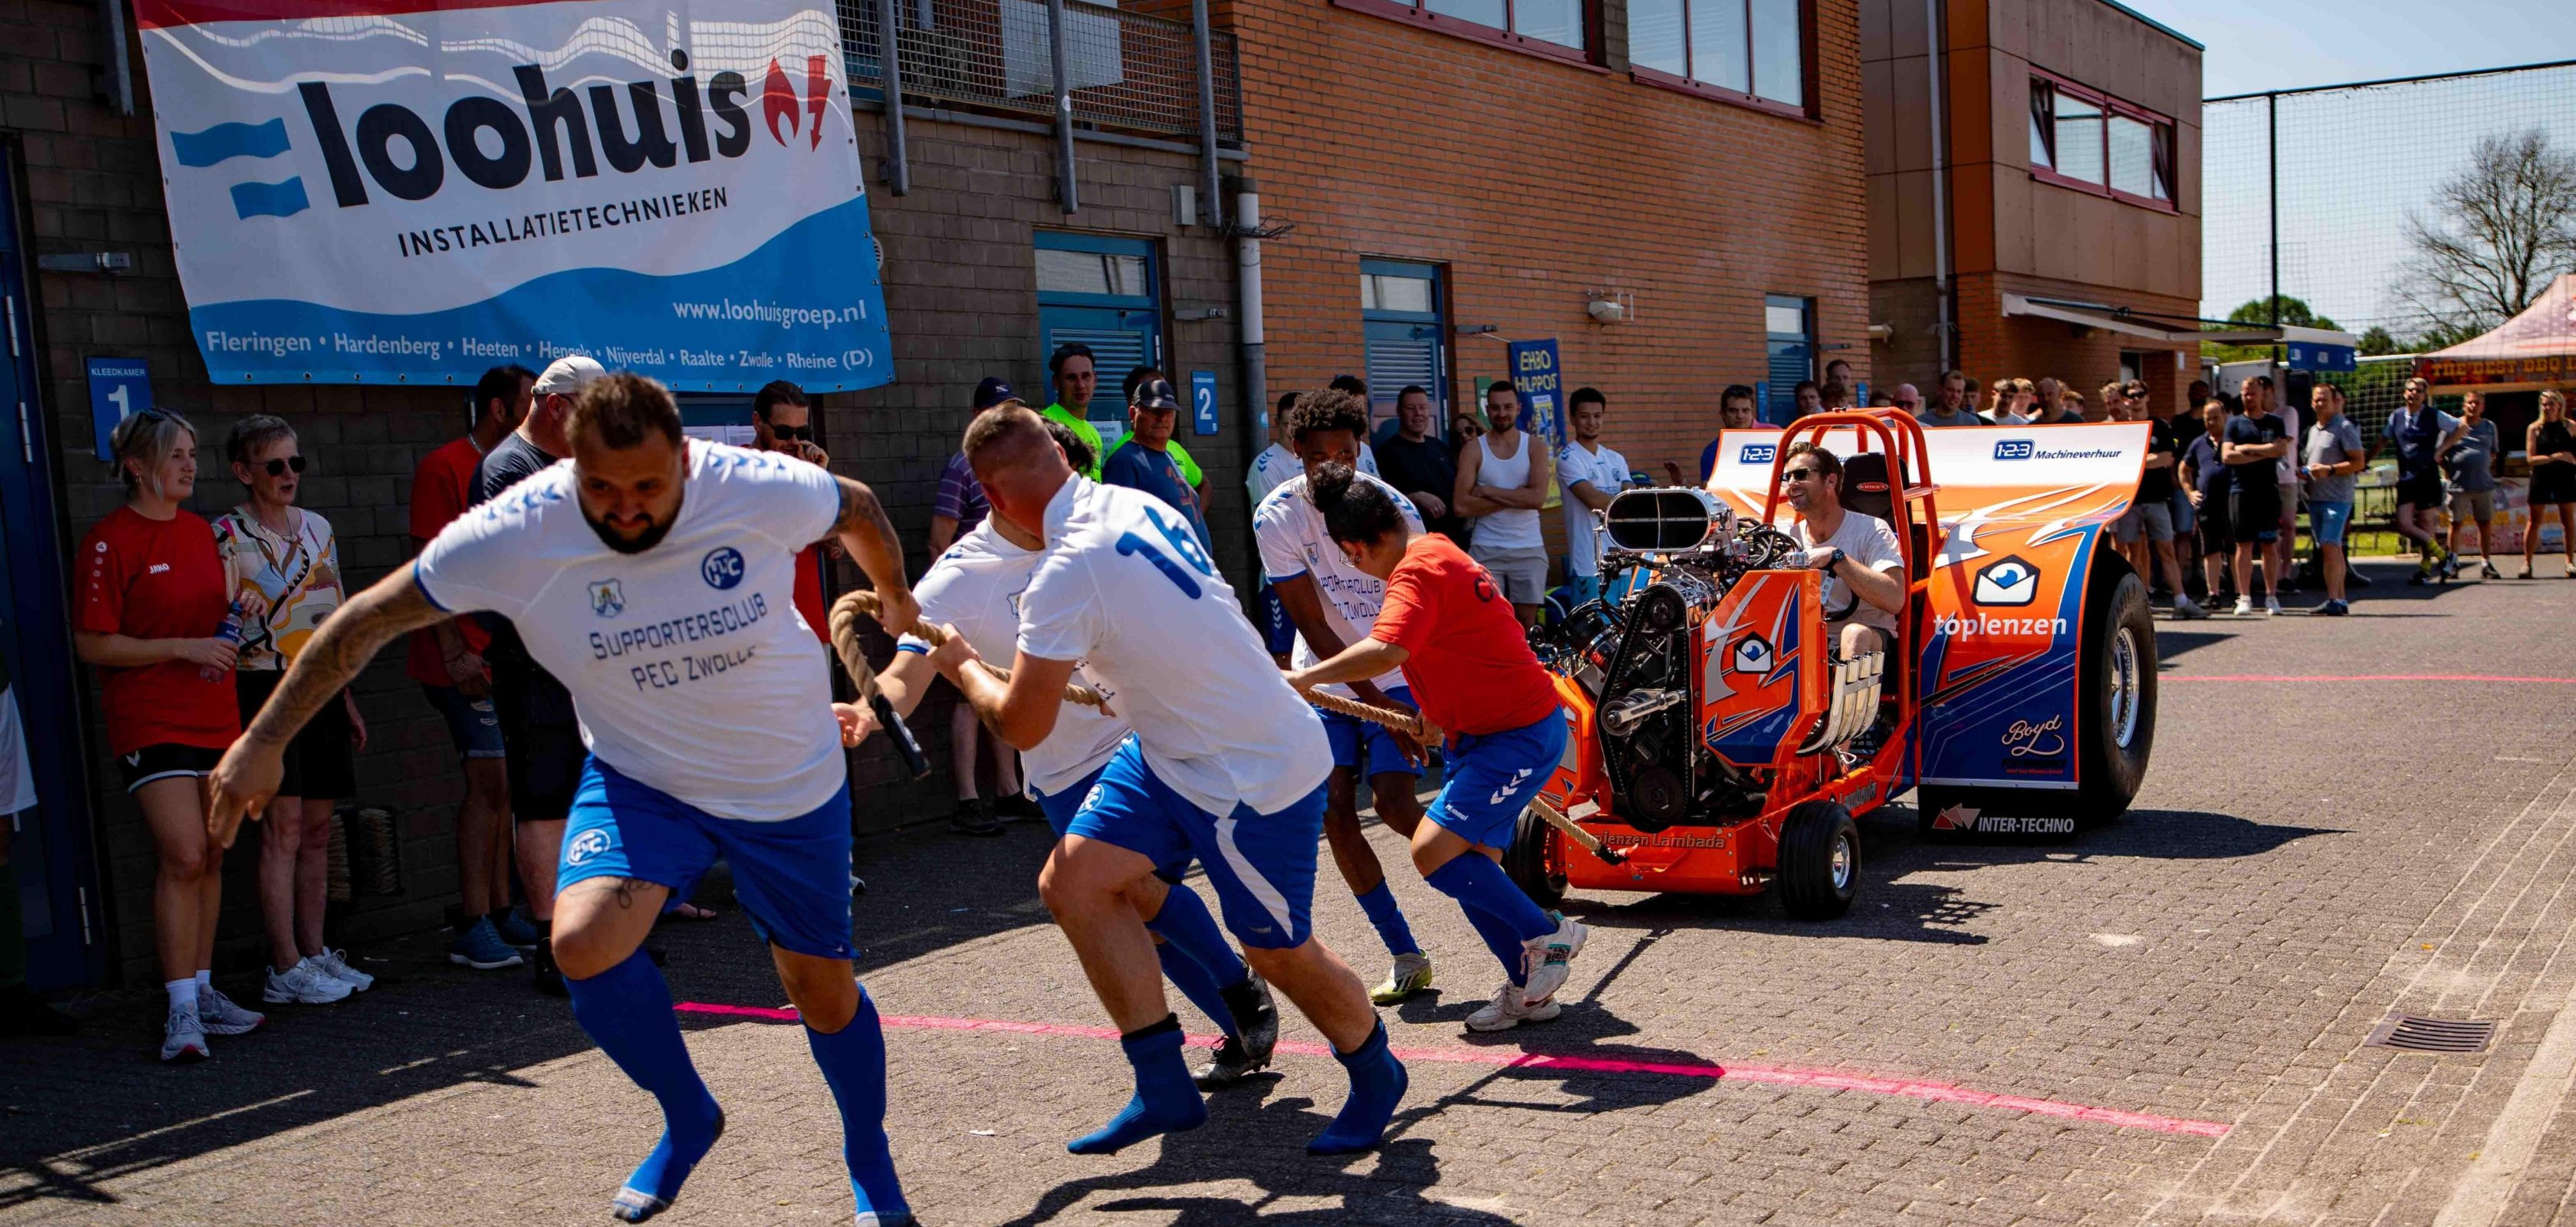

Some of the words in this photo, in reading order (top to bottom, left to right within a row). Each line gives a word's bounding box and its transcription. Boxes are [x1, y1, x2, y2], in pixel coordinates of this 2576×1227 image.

[297, 49, 751, 208] loohuis
[398, 186, 728, 258] INSTALLATIETECHNIEKEN
[673, 298, 866, 331] www.loohuisgroep.nl
[205, 331, 311, 357] Fleringen
[334, 332, 441, 360] Hardenberg
[462, 337, 519, 357] Heeten
[606, 346, 664, 368] Nijverdal
[680, 349, 725, 366] Raalte
[739, 350, 774, 367] Zwolle
[787, 352, 837, 369] Rheine
[843, 348, 873, 370] (D)
[1520, 350, 1552, 370] EHBO
[91, 368, 146, 377] KLEEDKAMER
[107, 385, 130, 423] 1
[1198, 387, 1213, 420] 2
[2034, 448, 2122, 459] Machineverhuur
[149, 563, 170, 574] JAKO
[1115, 505, 1213, 600] 16
[589, 592, 768, 660] SUPPORTERSCLUB
[1933, 613, 2068, 642] toplenzen
[630, 660, 679, 692] PEC
[2001, 714, 2065, 757] Boyd
[1593, 831, 1649, 846] plenzen
[1651, 834, 1727, 848] Lambada
[1978, 817, 2075, 833] INTER-TECHNO
